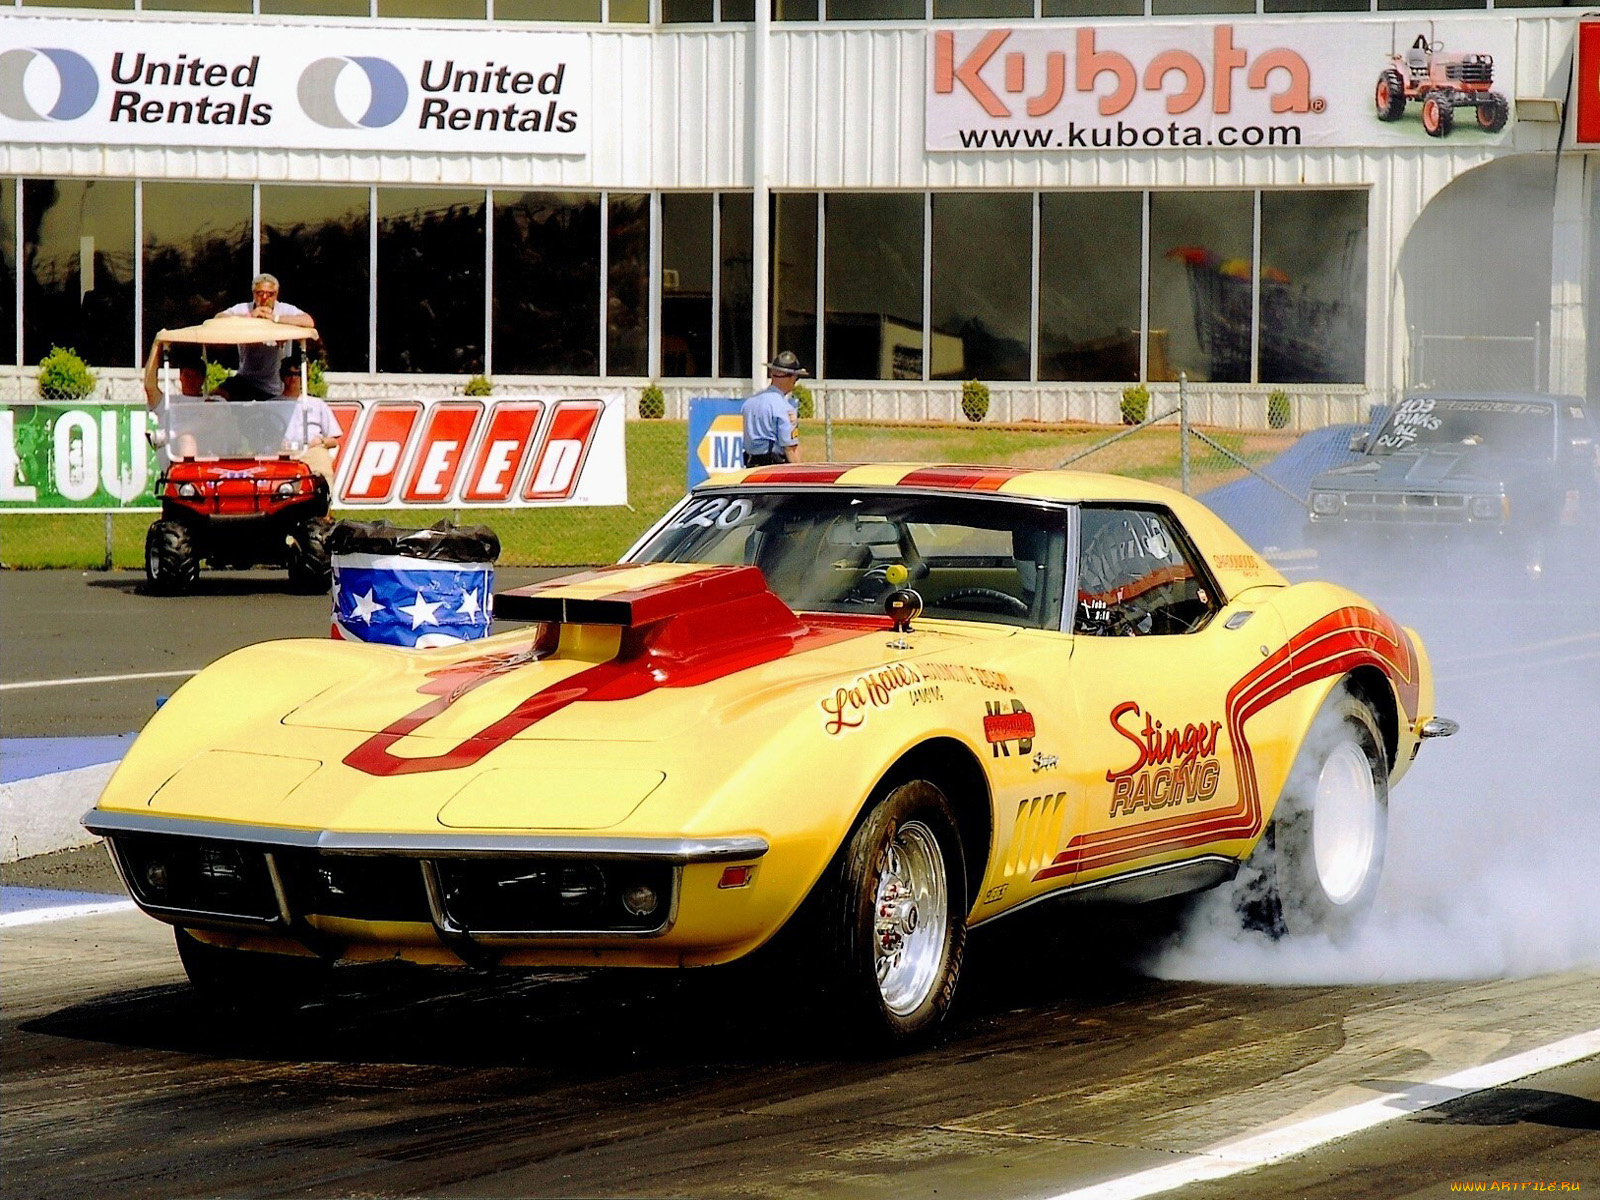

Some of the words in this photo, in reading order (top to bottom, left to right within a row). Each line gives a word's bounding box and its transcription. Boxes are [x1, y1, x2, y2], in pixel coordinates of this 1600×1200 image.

[110, 52, 260, 88] United
[420, 60, 566, 96] United
[109, 92, 273, 126] Rentals
[418, 98, 578, 133] Rentals
[959, 121, 1302, 148] www.kubota.com
[1393, 413, 1442, 430] PINKS
[1394, 425, 1417, 437] ALL
[0, 410, 158, 501] LOU
[1378, 435, 1414, 449] OUT
[329, 439, 583, 494] PEED
[1106, 701, 1222, 782] Stinger
[1109, 759, 1221, 818] RACING
